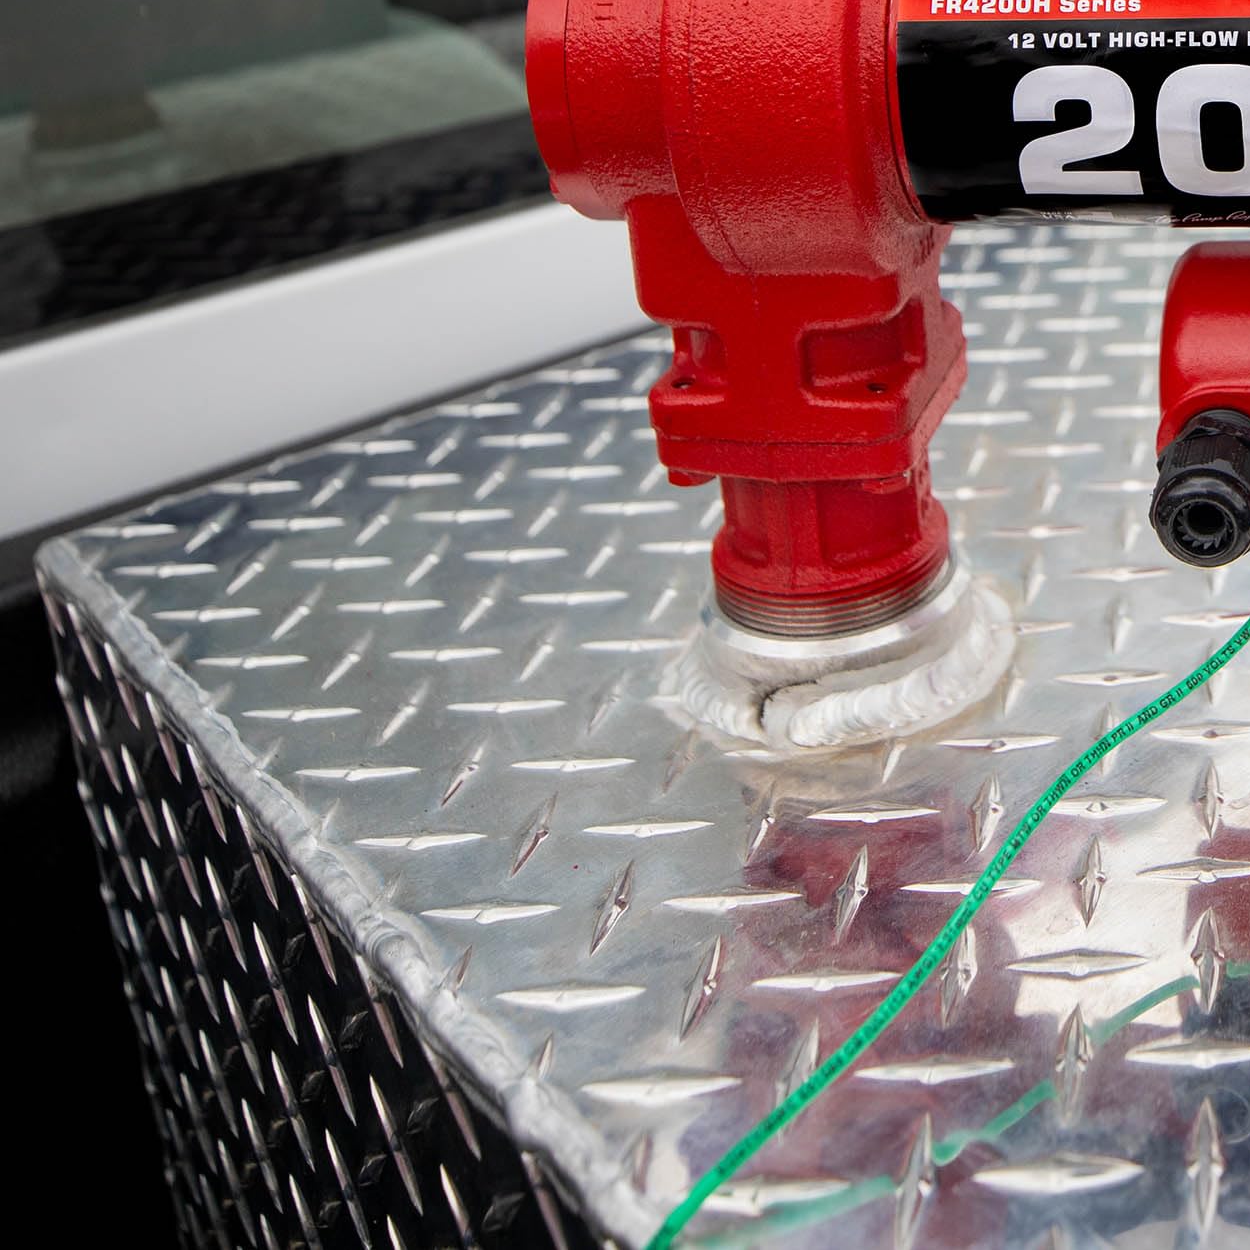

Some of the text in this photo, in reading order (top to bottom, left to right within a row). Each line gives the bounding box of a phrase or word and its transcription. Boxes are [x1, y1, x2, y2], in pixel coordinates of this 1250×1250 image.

[1008, 33, 1036, 49] 12
[1043, 32, 1101, 49] VOLT
[1108, 31, 1238, 48] HIGH-FLOW
[1033, 805, 1048, 823] OR
[1070, 762, 1086, 778] OR
[1111, 728, 1126, 743] PR
[1137, 705, 1158, 725] AND
[1203, 646, 1235, 675] VOLTS
